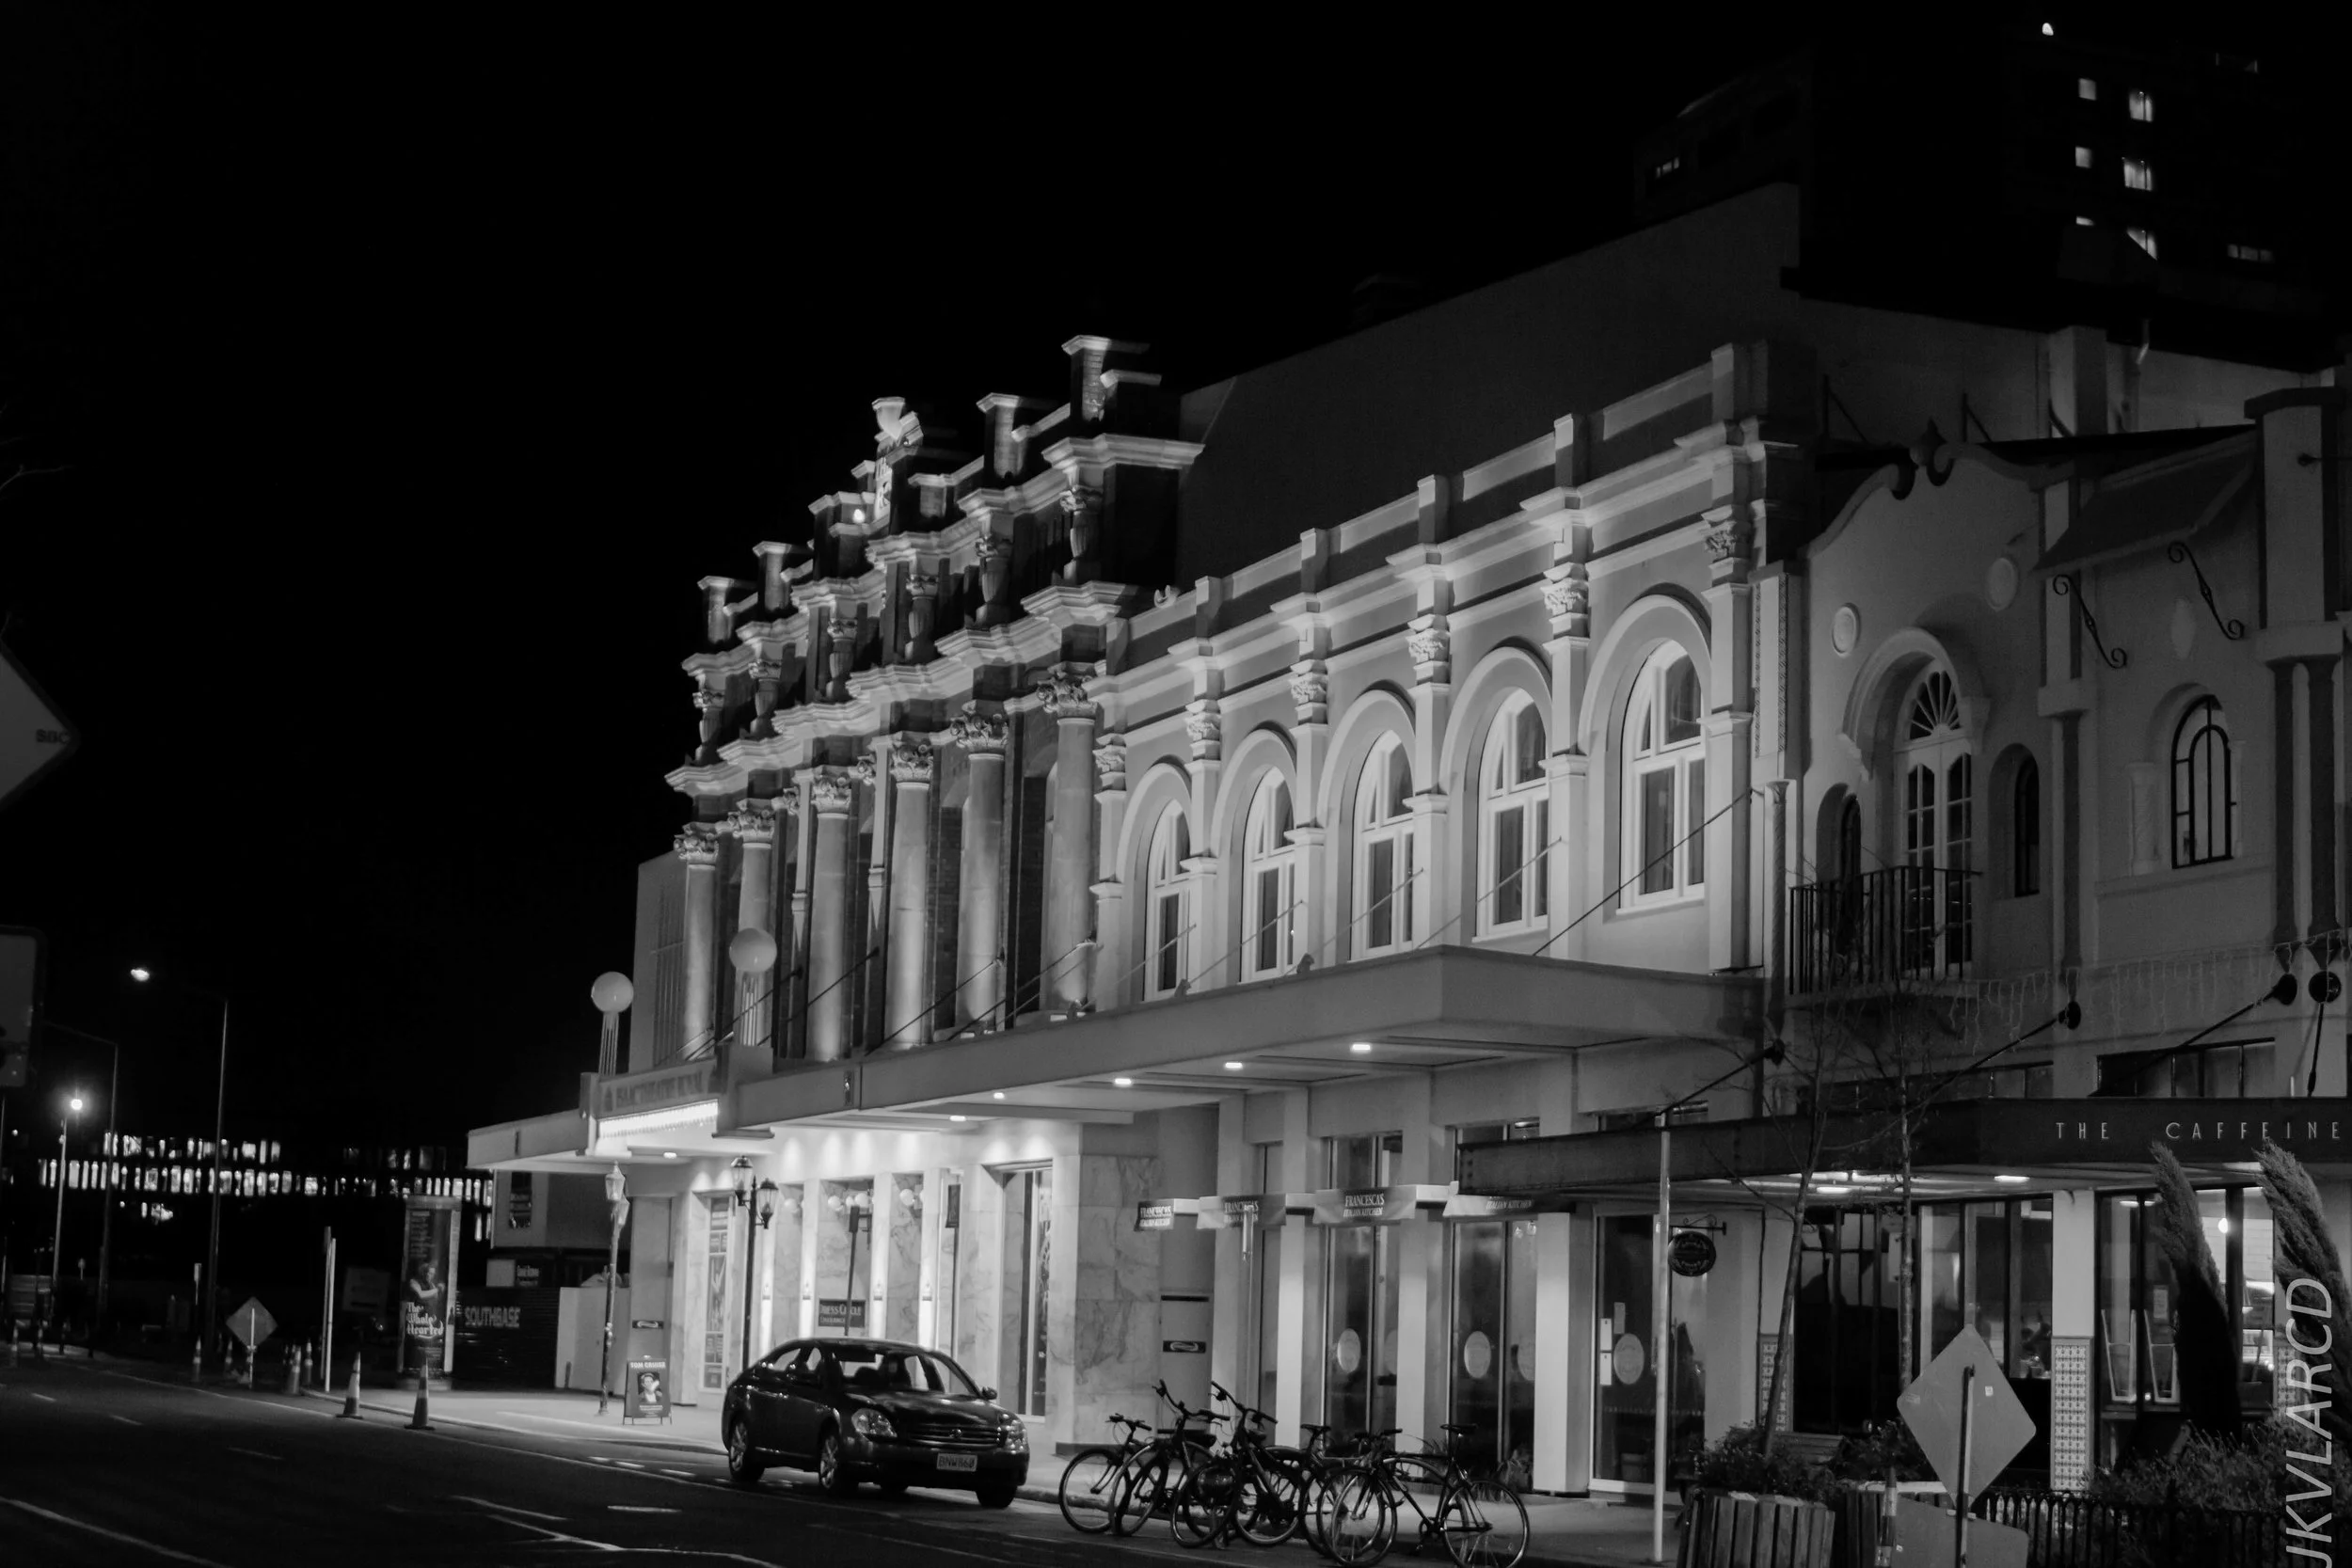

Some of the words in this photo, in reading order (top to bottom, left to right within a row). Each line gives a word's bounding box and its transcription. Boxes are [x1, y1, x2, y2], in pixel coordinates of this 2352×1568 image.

[2055, 1121, 2109, 1140] THE
[2165, 1121, 2341, 1140] CAFFEINE
[465, 1307, 521, 1328] SOUTHBASE
